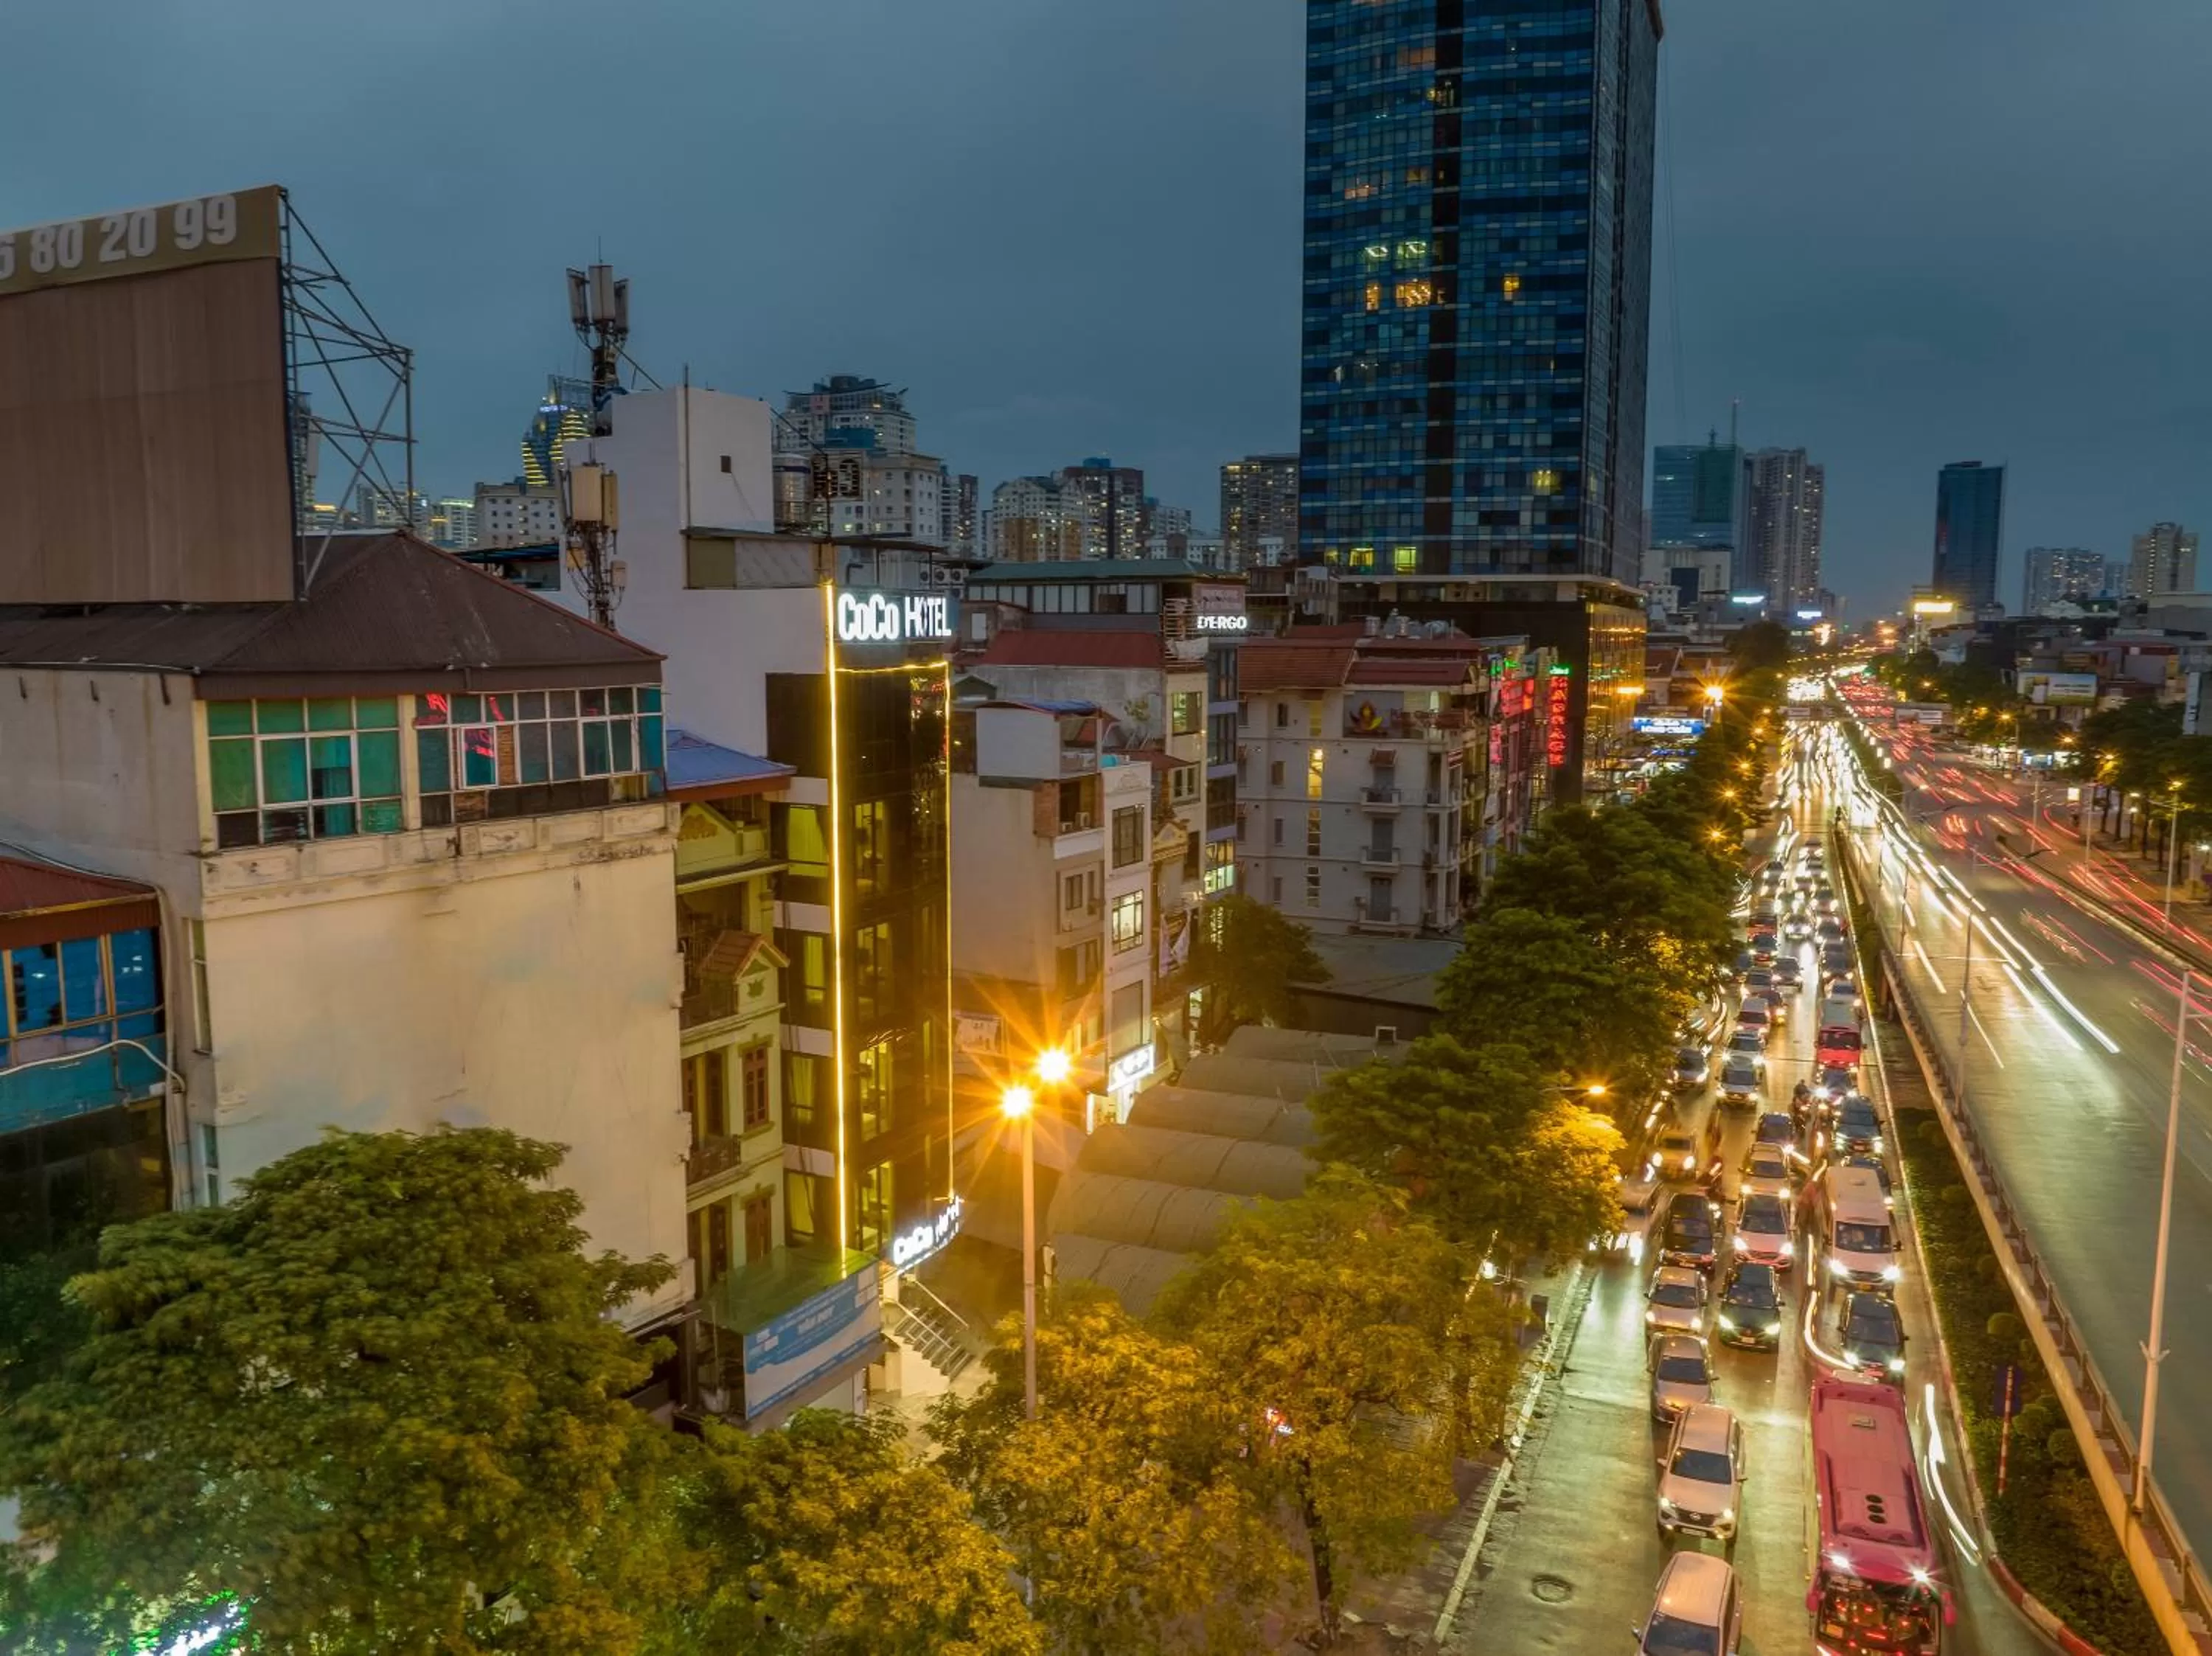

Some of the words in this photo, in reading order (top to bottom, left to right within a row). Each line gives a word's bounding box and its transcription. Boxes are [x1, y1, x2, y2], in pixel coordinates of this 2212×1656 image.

[30, 221, 83, 273] 80
[99, 208, 157, 262] 20
[173, 195, 237, 250] 99
[838, 593, 900, 640] CoCo
[905, 596, 952, 638] HOTEL
